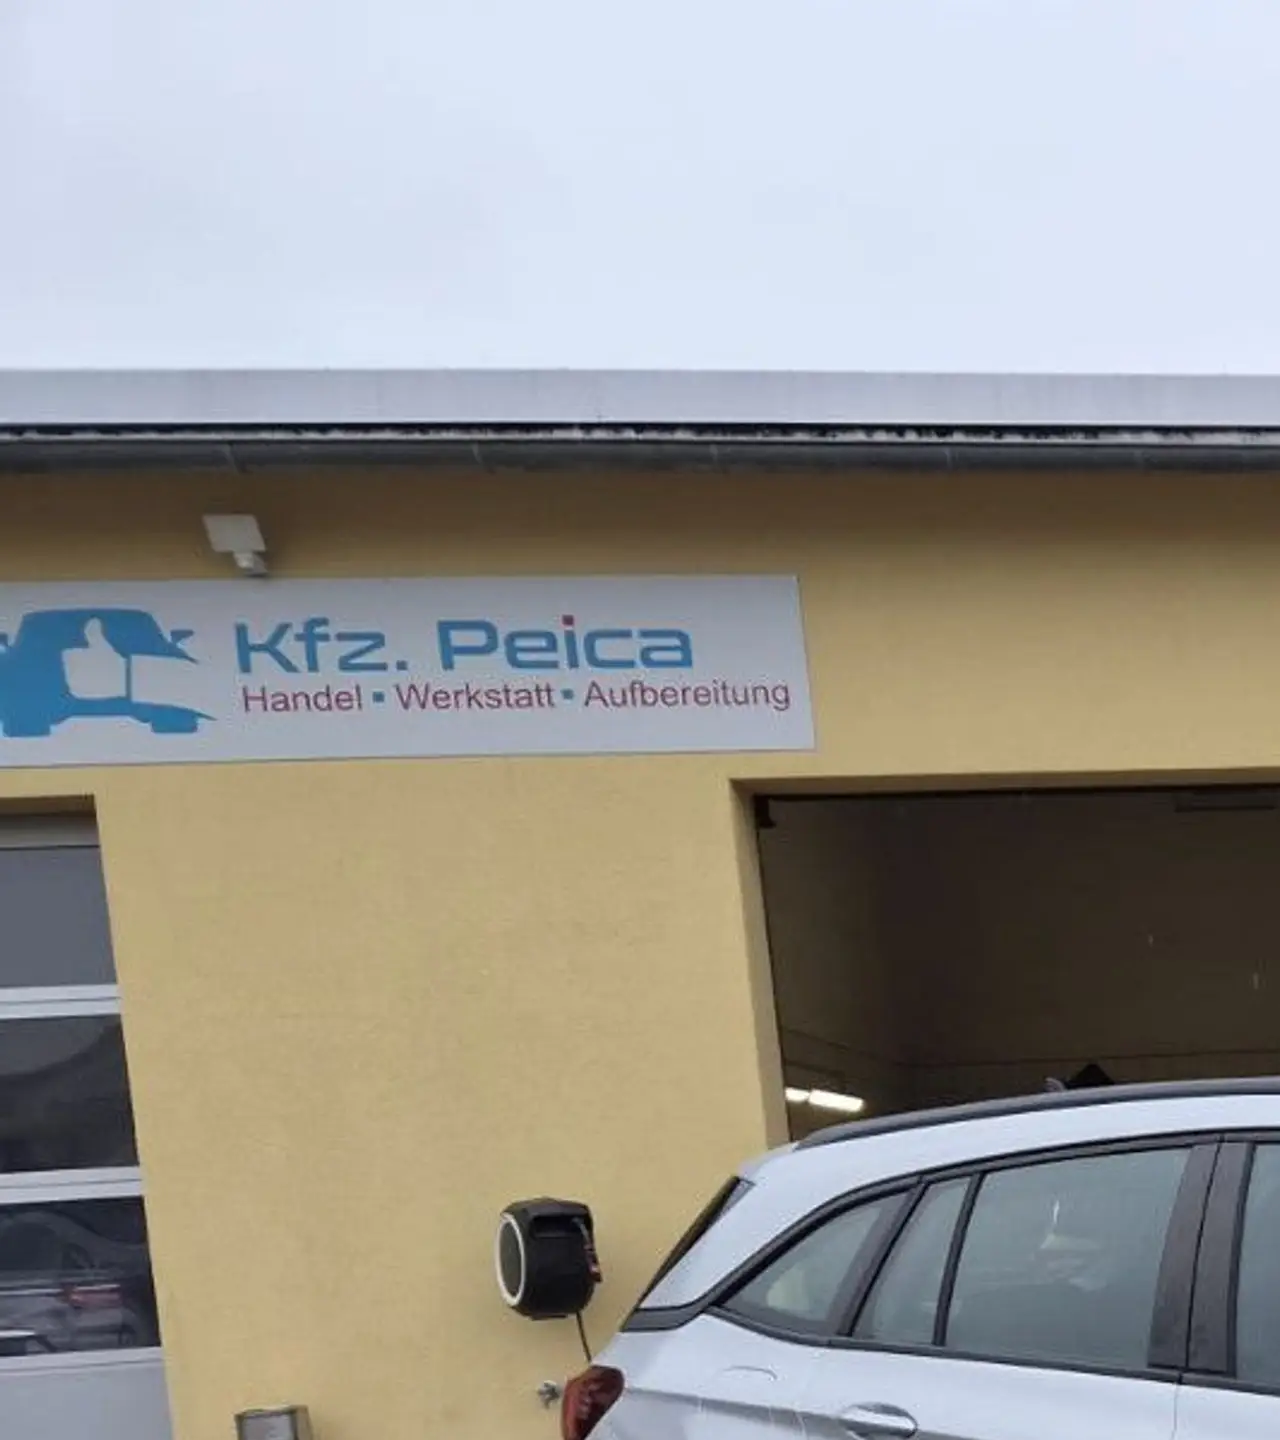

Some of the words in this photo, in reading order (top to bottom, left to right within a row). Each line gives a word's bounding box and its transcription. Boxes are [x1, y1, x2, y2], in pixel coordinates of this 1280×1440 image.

[234, 616, 408, 674] Kfz.
[437, 614, 693, 671] Peica
[241, 684, 363, 713] Handel
[395, 682, 555, 710] Werkstatt
[583, 679, 792, 712] Aufbereitung
